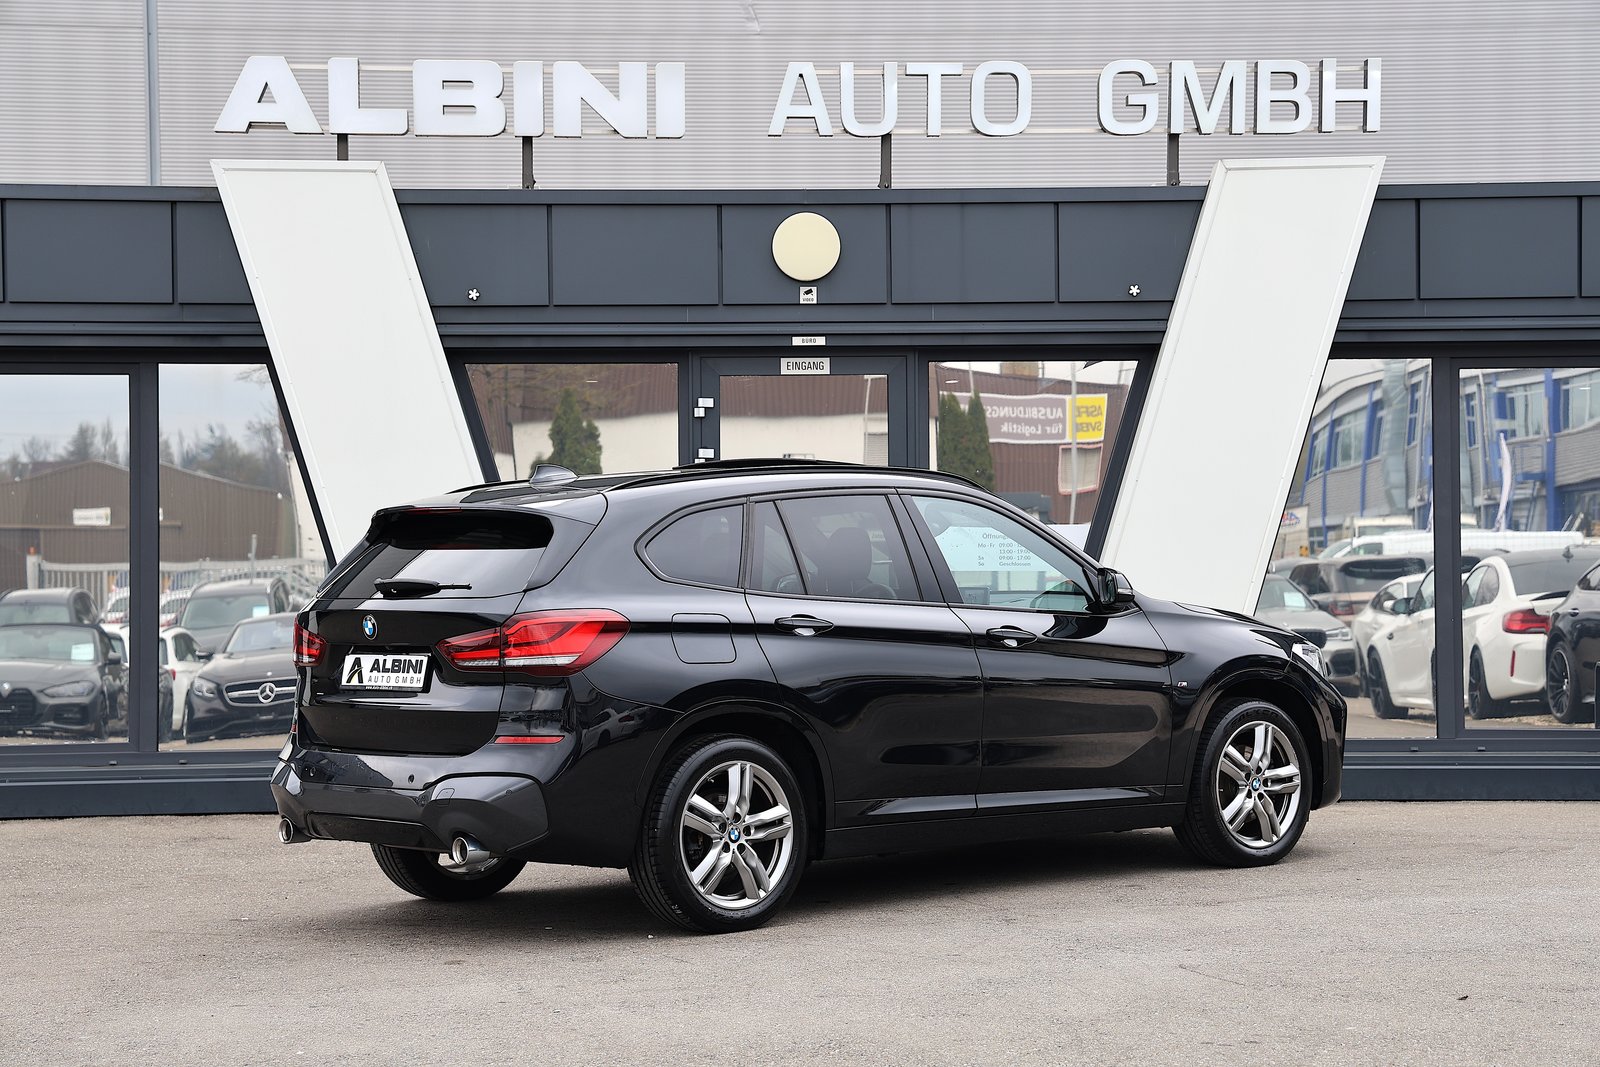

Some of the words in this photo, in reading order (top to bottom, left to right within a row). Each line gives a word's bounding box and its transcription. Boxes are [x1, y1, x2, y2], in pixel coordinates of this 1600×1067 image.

[214, 55, 686, 139] ALBINI
[767, 60, 1033, 137] AUTO
[1096, 58, 1382, 136] GMBH
[786, 361, 825, 371] EINGANG
[369, 658, 424, 674] ALBINI
[367, 675, 391, 684] AUTO
[394, 675, 422, 684] GMBH
